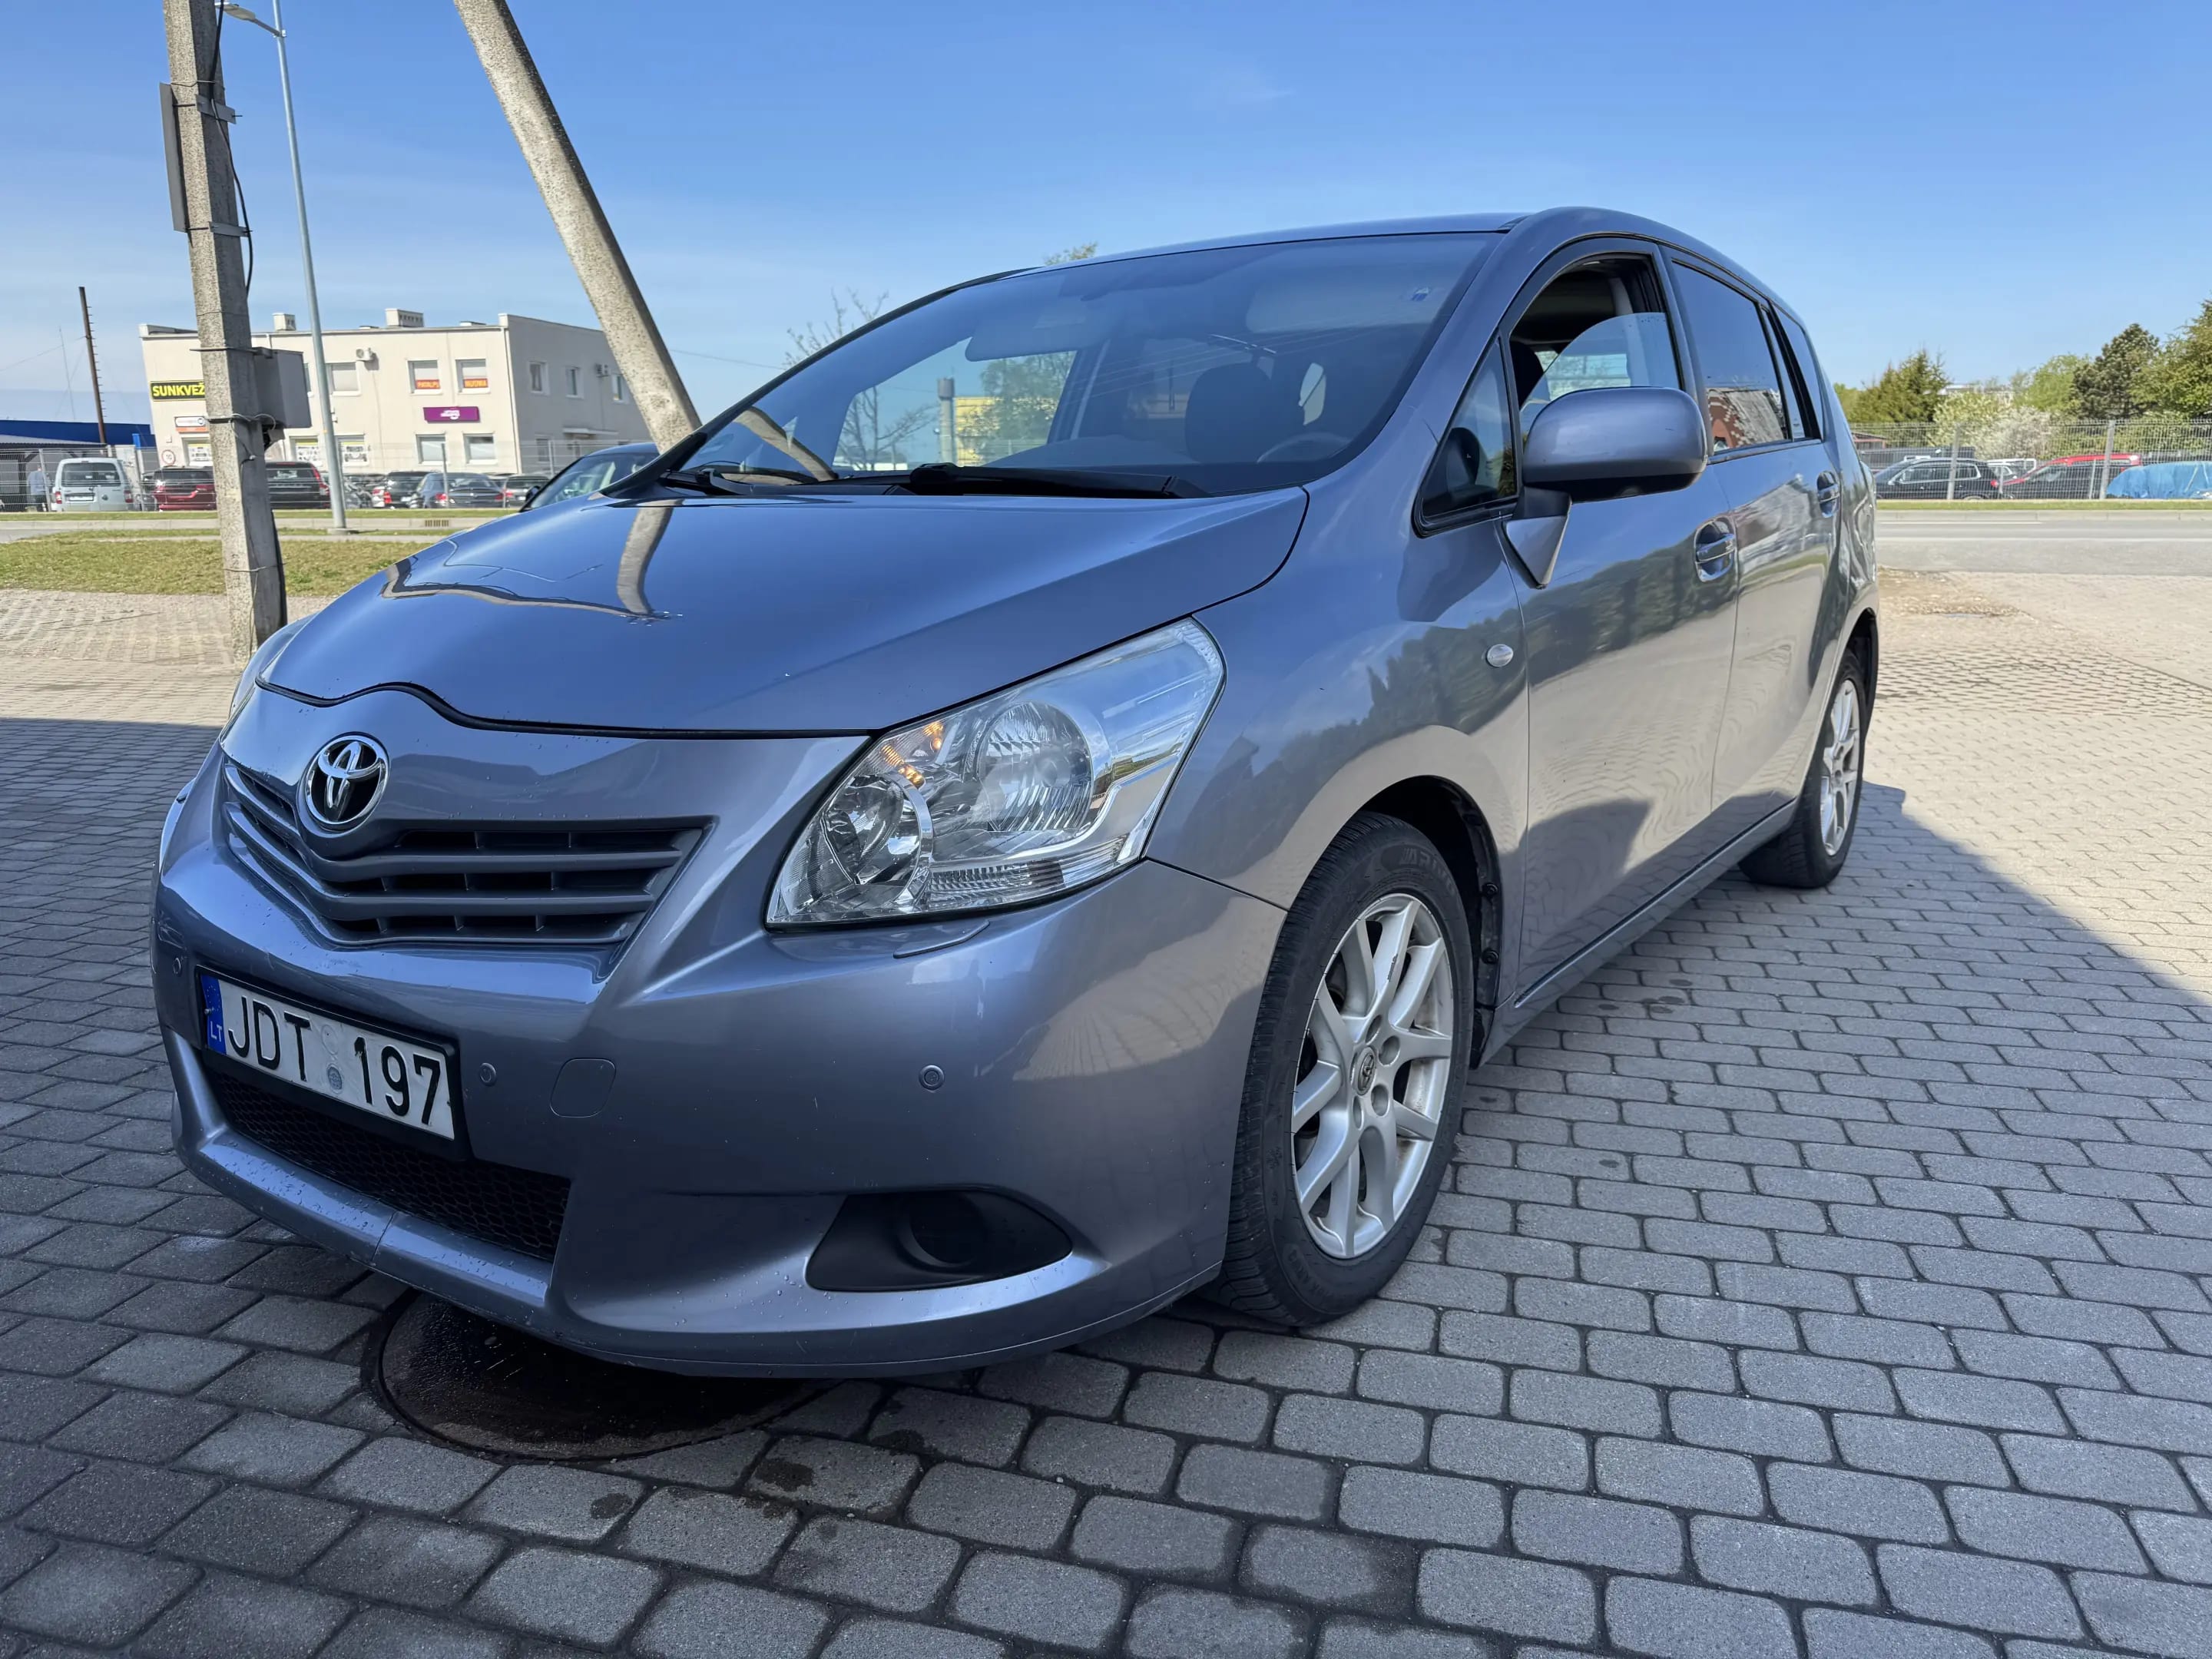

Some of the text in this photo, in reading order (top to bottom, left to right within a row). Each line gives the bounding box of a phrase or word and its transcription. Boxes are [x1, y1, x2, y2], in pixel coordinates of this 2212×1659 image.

[210, 1023, 223, 1043] LT
[227, 995, 441, 1127] JDT 197
